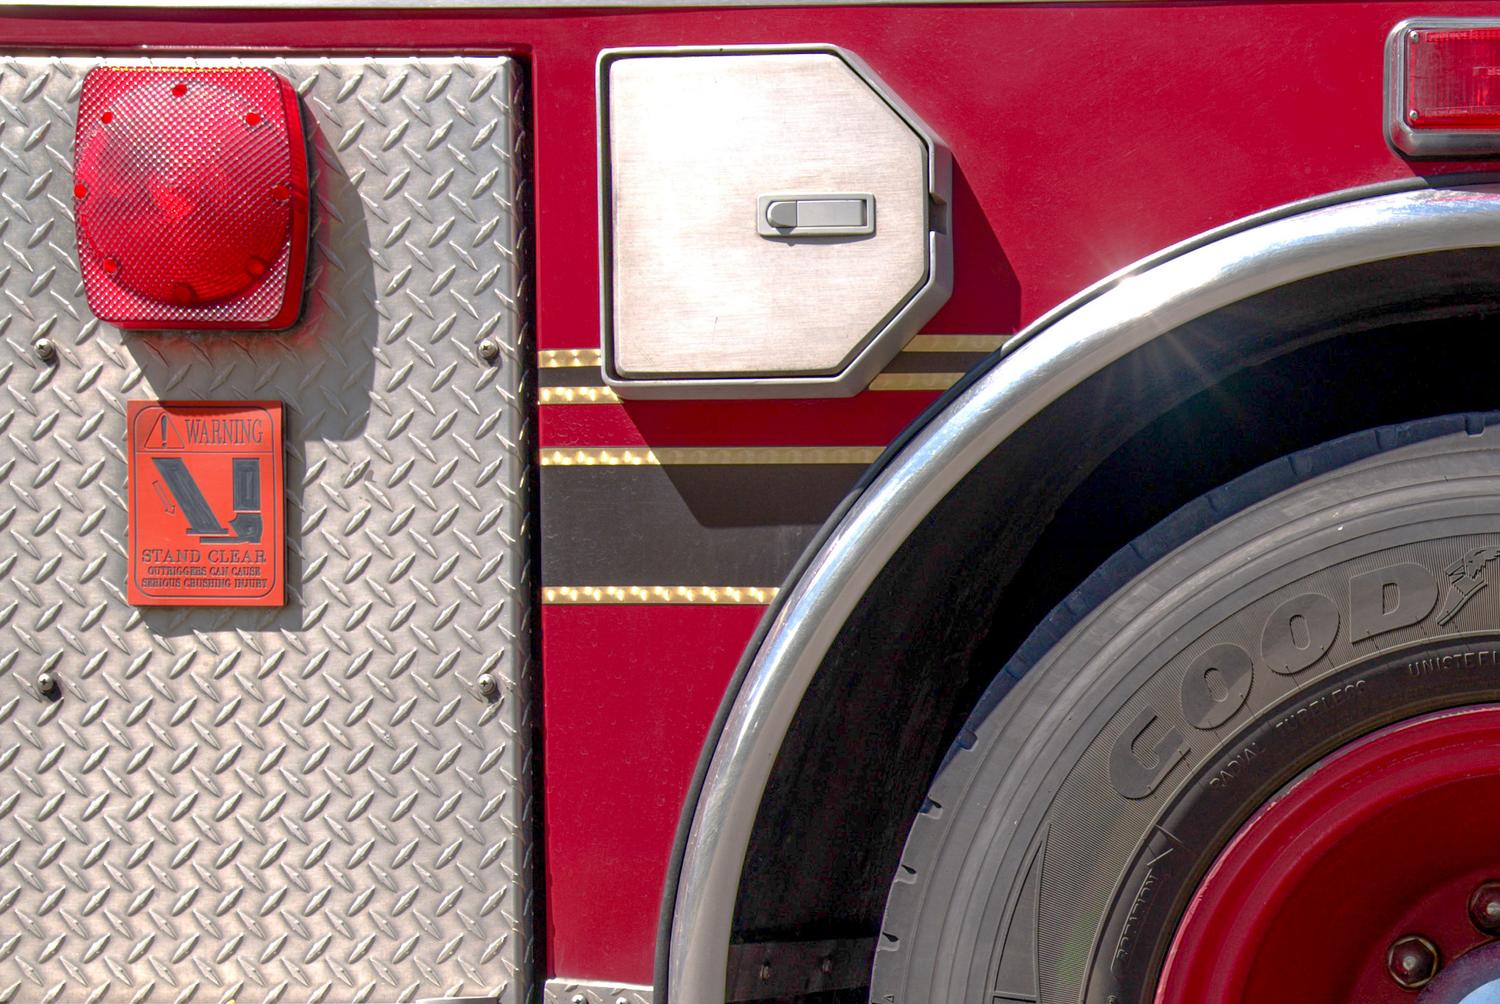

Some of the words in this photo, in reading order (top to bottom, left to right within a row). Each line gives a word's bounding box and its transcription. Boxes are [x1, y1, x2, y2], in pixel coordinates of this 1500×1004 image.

[184, 418, 264, 445] WARNING
[142, 549, 200, 563] STAND
[208, 549, 267, 563] CLEAR
[147, 566, 207, 576] OUTRIGGERS
[209, 566, 228, 576] CAN
[231, 566, 261, 576] CAUSE
[142, 578, 181, 588] SERIOUS
[183, 578, 231, 588] CRUSHING
[234, 578, 268, 588] INJURY
